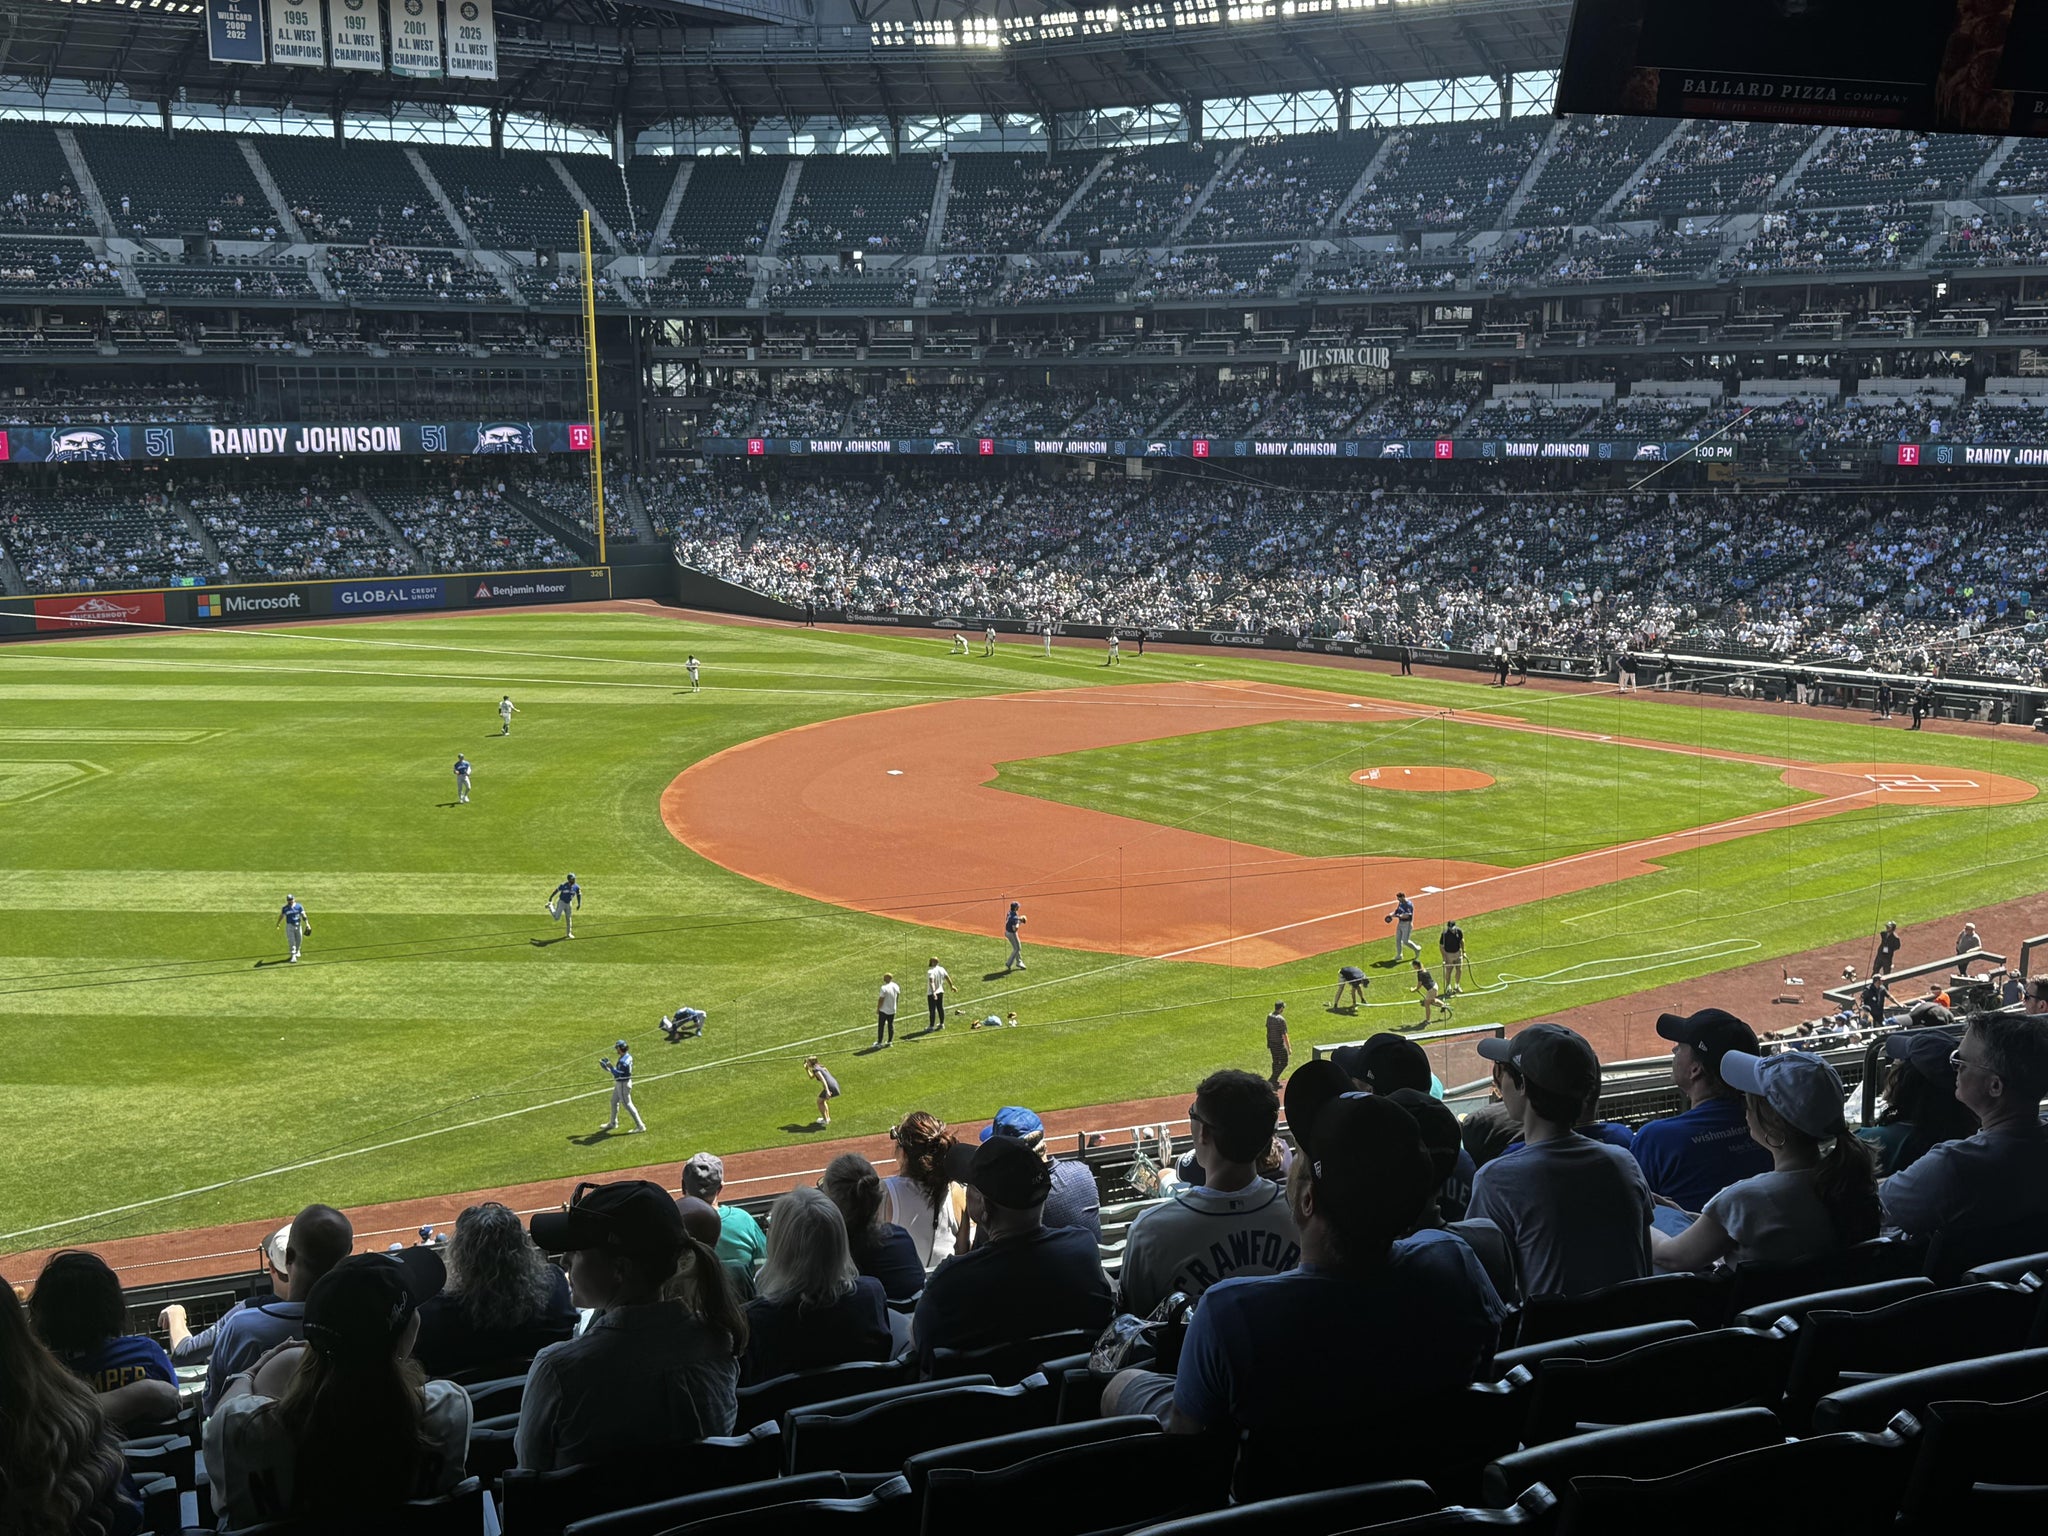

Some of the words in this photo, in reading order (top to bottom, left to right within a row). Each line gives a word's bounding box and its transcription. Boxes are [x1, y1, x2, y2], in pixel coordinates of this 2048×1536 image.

[217, 11, 234, 20] WILD
[235, 12, 252, 21] CARD
[284, 10, 308, 25] 1995
[344, 15, 366, 30] 1997
[225, 21, 246, 30] 2000
[403, 20, 427, 35] 2001
[459, 25, 482, 40] 2025
[226, 30, 246, 39] 2022
[278, 28, 293, 40] A.L.
[294, 29, 316, 42] WEST
[338, 33, 352, 45] A.L.
[353, 34, 374, 46] WEST
[274, 43, 322, 58] CHAMPIONS
[398, 37, 412, 50] A.L.
[413, 39, 433, 51] WEST
[455, 42, 468, 54] A.L.
[469, 43, 488, 56] WEST
[334, 48, 380, 63] CHAMPIONS
[394, 52, 439, 67] CHAMPIONS
[451, 57, 493, 72] CHAMPIONS
[1682, 79, 1774, 96] BALLARD
[1780, 84, 1837, 101] PIZZA
[1844, 92, 1909, 103] COMPANY
[1298, 349, 1320, 372] ALL
[1325, 347, 1355, 365] STAR
[1358, 347, 1390, 370] CLUB
[145, 428, 175, 456] 51
[210, 427, 287, 454] RANDY
[295, 425, 401, 453] JOHNSON
[421, 425, 447, 451] 51
[789, 440, 801, 453] 51
[810, 440, 843, 453] RANDY
[845, 441, 891, 453] JOHNSON
[899, 441, 910, 453] 51
[1016, 441, 1027, 454] 51
[1034, 440, 1063, 454] RANDY
[1065, 441, 1107, 454] JOHNSON
[1114, 441, 1126, 455] 51
[1234, 443, 1246, 456] 51
[1255, 442, 1288, 455] RANDY
[1290, 442, 1337, 455] JOHNSON
[1345, 443, 1359, 456] 51
[1482, 443, 1496, 457] 51
[1505, 442, 1539, 457] RANDY
[1541, 443, 1590, 457] JOHNSON
[1598, 443, 1611, 458] 51
[1695, 446, 1714, 457] 1:00
[1717, 446, 1732, 457] PM
[1937, 447, 1952, 463] 51
[1965, 447, 2010, 464] RANDY
[590, 570, 603, 578] 326
[341, 588, 408, 605] GLOBAL
[411, 587, 438, 595] CREDIT
[493, 583, 535, 597] Benjamin
[536, 583, 565, 594] Moore
[225, 592, 301, 612] Microsoft
[1026, 622, 1066, 635] STHL
[1113, 628, 1139, 637] Great
[1225, 635, 1264, 645] LEXUS
